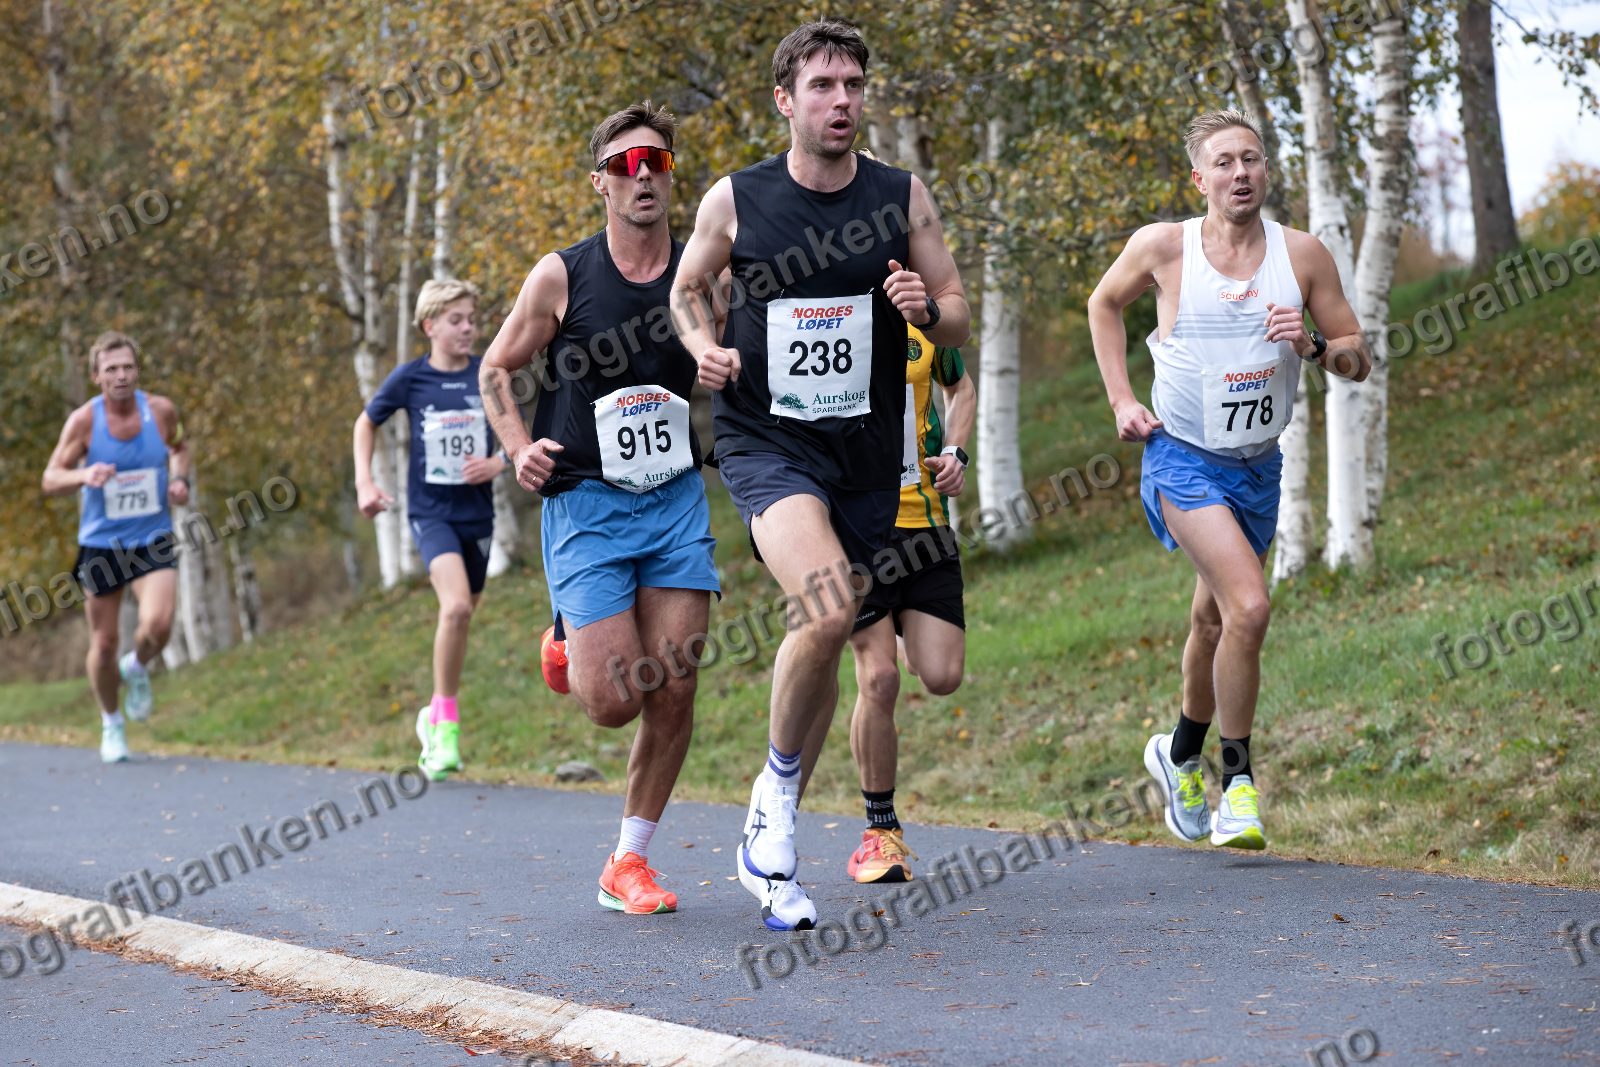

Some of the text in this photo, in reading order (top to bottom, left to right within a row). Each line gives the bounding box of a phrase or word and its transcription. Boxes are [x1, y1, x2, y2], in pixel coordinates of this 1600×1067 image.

[791, 305, 853, 318] NORGES
[797, 318, 844, 331] LØPET
[789, 338, 853, 376] 238
[1223, 367, 1276, 382] NORGES
[1228, 379, 1268, 393] LØPET
[615, 393, 671, 408] NORGES
[812, 390, 866, 406] Aurskog
[622, 402, 662, 418] LØPET
[1221, 395, 1273, 431] 778
[439, 434, 475, 457] 193
[617, 420, 672, 461] 915
[643, 466, 691, 484] Aursko
[116, 489, 149, 510] 779
